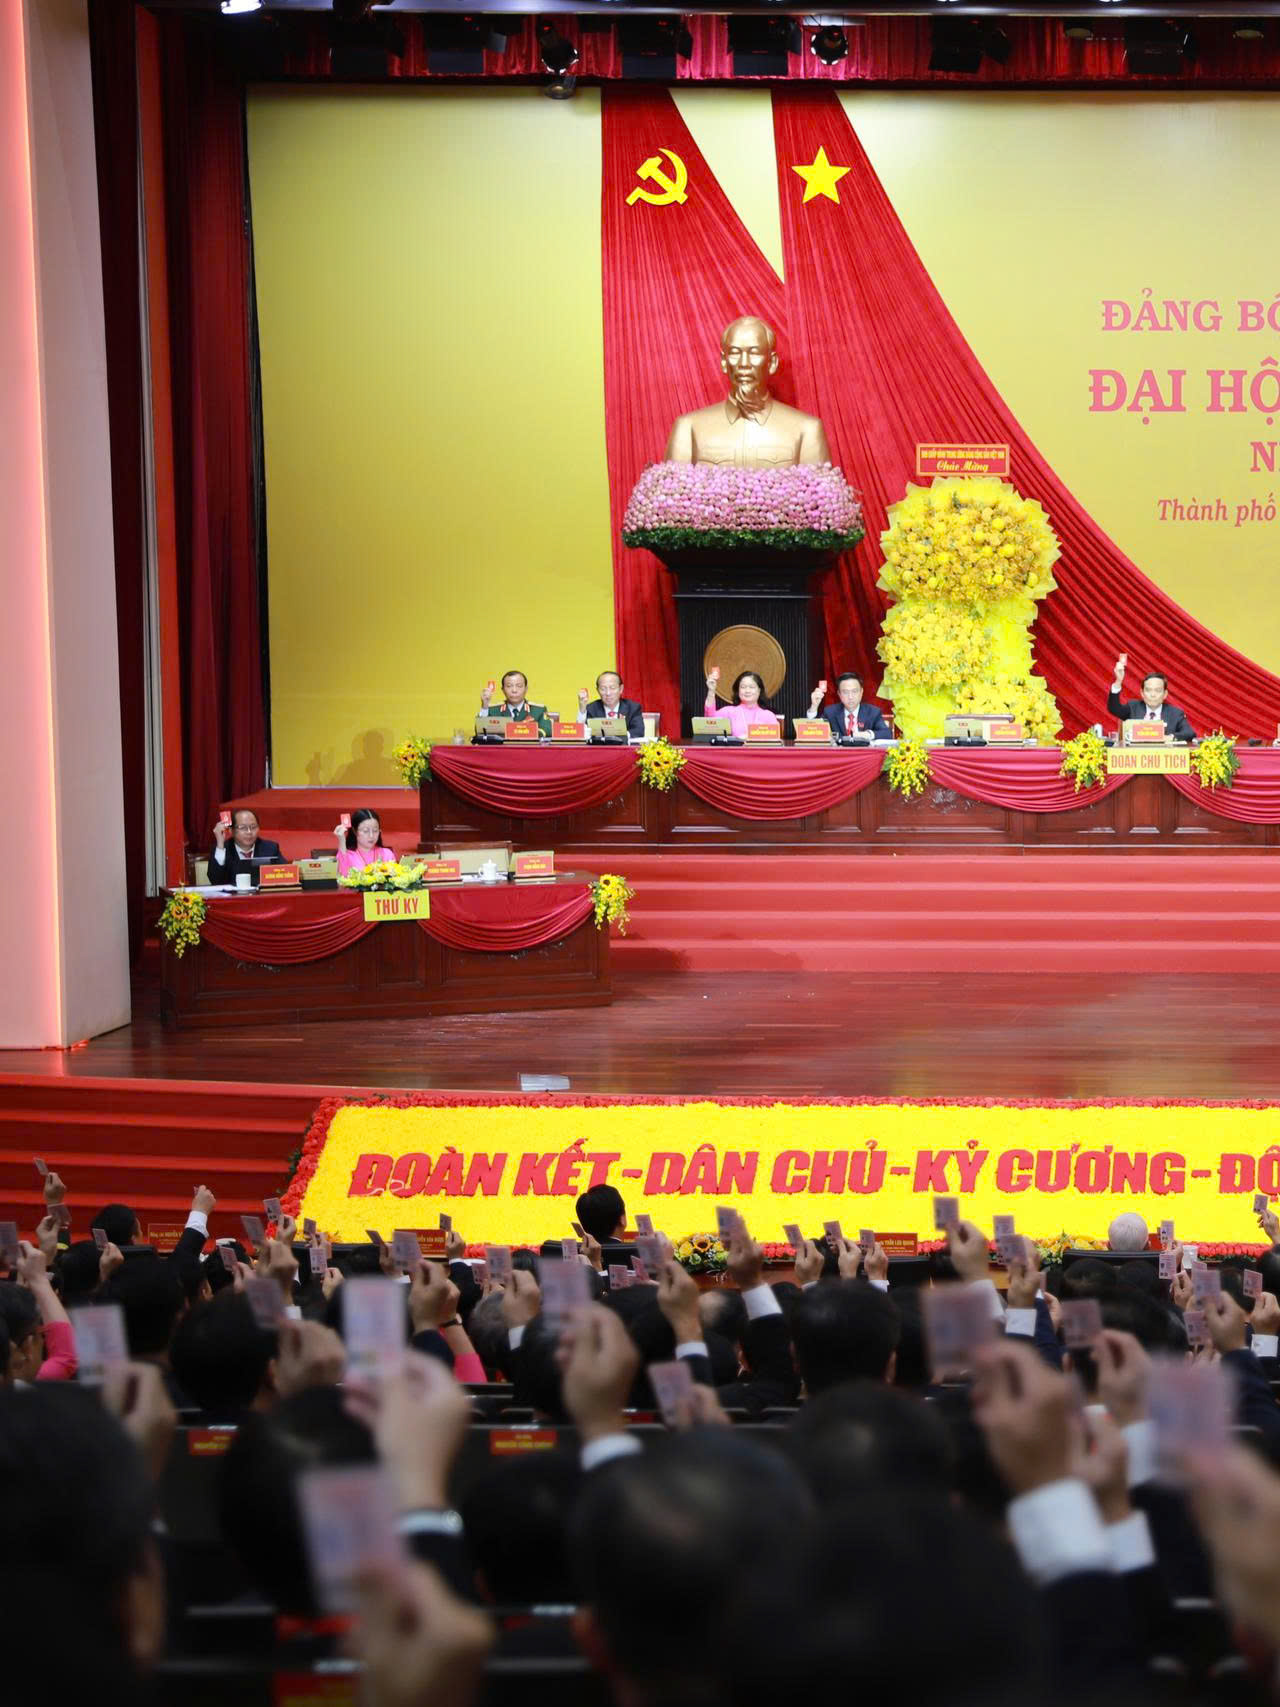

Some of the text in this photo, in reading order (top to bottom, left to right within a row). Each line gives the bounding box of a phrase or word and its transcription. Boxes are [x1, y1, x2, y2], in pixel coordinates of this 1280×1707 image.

[1102, 288, 1224, 332] ĐẢNG
[1088, 369, 1188, 425] ĐẠI
[1158, 499, 1229, 522] Thành
[1235, 494, 1278, 528] phố
[348, 1145, 509, 1198] ĐOÀN
